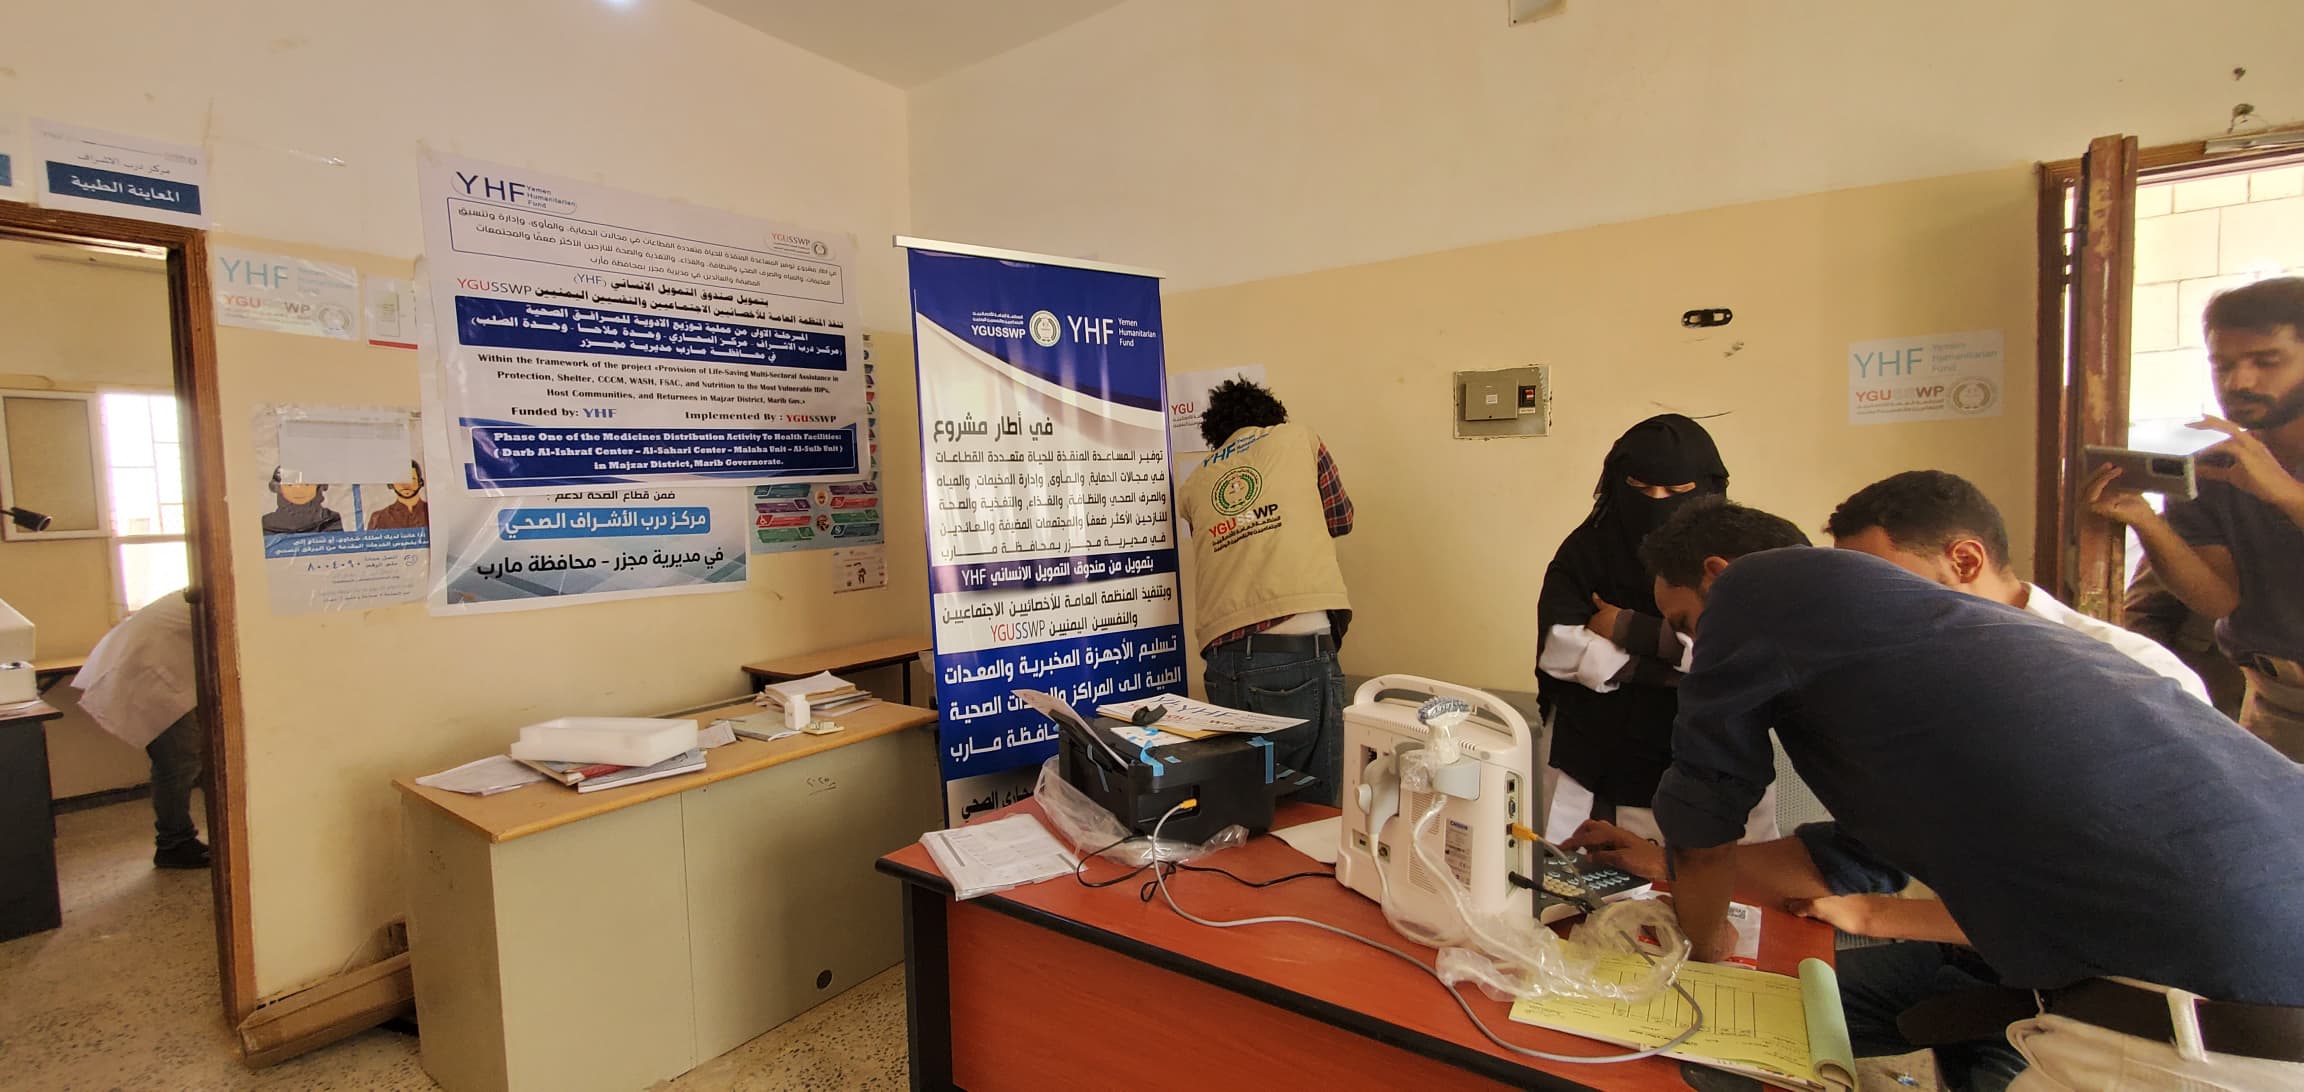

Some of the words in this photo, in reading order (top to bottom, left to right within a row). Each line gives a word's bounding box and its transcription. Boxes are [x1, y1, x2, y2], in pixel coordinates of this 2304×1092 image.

[71, 175, 123, 194] الطبية
[456, 171, 525, 202] YHF
[128, 184, 180, 202] المعاينة
[458, 207, 495, 220] وتنسيق
[476, 225, 531, 241] والمجتمعات
[220, 256, 289, 289] YHF
[457, 278, 532, 296] YGUSSWP
[658, 284, 697, 297] التمويل
[700, 291, 734, 302] صندوق
[737, 293, 769, 306] بتمويل
[526, 304, 569, 318] الصحية
[971, 325, 1026, 339] YGUSSWP
[1067, 315, 1114, 345] YHF
[1118, 318, 1138, 327] Yemen
[1119, 329, 1156, 338] Humanitarian
[1119, 338, 1135, 347] Fund
[478, 353, 513, 364] Within
[516, 356, 533, 365] the
[536, 357, 589, 368] framework
[591, 360, 601, 369] of
[604, 361, 618, 370] the
[621, 362, 652, 373] project
[708, 368, 749, 378] Life-Saving
[799, 373, 831, 382] Assistance
[1854, 347, 1923, 379] YHF
[497, 371, 554, 382] Protection,
[557, 373, 594, 384] Shelter,
[598, 375, 627, 385] CCCM,
[660, 379, 683, 388] FSAC,
[685, 380, 700, 388] and
[702, 381, 735, 390] Nutrition
[747, 383, 758, 391] the
[760, 384, 776, 392] Most
[778, 385, 812, 393] Vulnerable
[547, 389, 569, 398] Host
[572, 389, 636, 400] Communities,
[638, 391, 654, 400] and
[657, 392, 698, 401] Returnees
[710, 394, 735, 403] Majzar
[737, 395, 766, 404] District,
[768, 396, 786, 404] Marib
[511, 407, 557, 416] Funded
[561, 407, 579, 417] by:
[583, 408, 617, 418] YHF
[685, 411, 760, 421] Implemented
[764, 413, 776, 422] By
[785, 415, 837, 423] YGUSSWP
[933, 412, 989, 443] مشروع
[995, 411, 1023, 442] أطار
[1030, 415, 1054, 439] في
[494, 432, 535, 442] Phase
[538, 432, 563, 442] One
[566, 432, 579, 442] of
[581, 432, 600, 442] the
[603, 432, 661, 442] Medicines
[663, 433, 725, 442] Distribution
[726, 433, 761, 443] Activity
[762, 433, 773, 441] To
[774, 433, 802, 441] Health
[804, 433, 842, 441] Facilities:
[502, 448, 535, 457] Darb
[538, 447, 593, 457] Al-Ishraf
[595, 447, 633, 457] Center
[643, 446, 696, 455] Al-Sahari
[699, 446, 731, 455] Center
[734, 446, 768, 454] Malaha
[793, 445, 822, 453] Al-Sulb
[936, 450, 984, 463] القطاعات
[988, 451, 1025, 463] متعددة
[1028, 451, 1054, 465] للحياة
[1057, 450, 1090, 463] المنقذة
[1093, 449, 1136, 462] المساعدة
[1138, 450, 1164, 465] توفير
[594, 461, 607, 470] in
[609, 460, 648, 471] Majzar
[650, 459, 693, 469] District,
[694, 458, 724, 467] Marib
[725, 458, 784, 467] Governorate.
[937, 474, 970, 489] والمياه
[1019, 473, 1044, 488] وإدارة
[1120, 471, 1148, 484] مجالات
[1150, 472, 1165, 485] في
[555, 491, 582, 503] لدعم
[588, 490, 618, 501] الصحة
[624, 490, 650, 503] قطاع
[654, 492, 675, 502] ضمن
[981, 495, 1023, 511] والتغذية
[1110, 492, 1136, 505] الصحي
[1138, 492, 1166, 504] والصرف
[939, 497, 977, 513] والصحة
[505, 512, 566, 538] الصحي
[570, 511, 637, 529] الأشراف
[641, 513, 668, 528] درب
[671, 511, 706, 527] مركز
[940, 517, 995, 536] والعائدين
[998, 516, 1032, 531] المضيفة
[1035, 514, 1083, 529] والمجتمعات
[1111, 510, 1133, 528] الأكثر
[1135, 511, 1168, 526] للنازحين
[1063, 536, 1102, 553] مجزر
[1104, 534, 1148, 548] مديرية
[1150, 533, 1166, 544] في
[941, 544, 998, 561] مارب
[1001, 539, 1061, 555] بمحافظة
[528, 554, 597, 573] محافظة
[614, 552, 648, 571] مجزر
[653, 550, 701, 569] مديرية
[704, 547, 724, 569] في
[1124, 556, 1154, 573] بتمويل
[477, 557, 523, 578] مارب
[990, 564, 1032, 586] الانساني
[1035, 563, 1070, 582] التمويل
[1074, 561, 1104, 576] صندوق
[1108, 560, 1122, 574] من
[961, 568, 987, 587] YHF
[1064, 591, 1098, 608] العامة
[1101, 587, 1138, 603] المنظمة
[1141, 585, 1172, 602] وبتنفيذ
[942, 600, 1004, 625] الاجتماعيين
[1008, 594, 1060, 617] للأخصائيين
[1049, 615, 1088, 637] اليمنيين
[1092, 612, 1138, 630] والنفسيين
[991, 622, 1046, 642] YGUSSWP
[1085, 638, 1133, 665] الأجهزة
[1139, 635, 1177, 662] تسليم
[944, 657, 1014, 685] والمعدات
[1019, 649, 1080, 679] المخبرية
[1118, 673, 1142, 692] الى
[1146, 666, 1182, 689] الطبية
[1072, 678, 1114, 707] المراكز
[950, 695, 1002, 723] الصحية
[951, 735, 1002, 762] مارب
